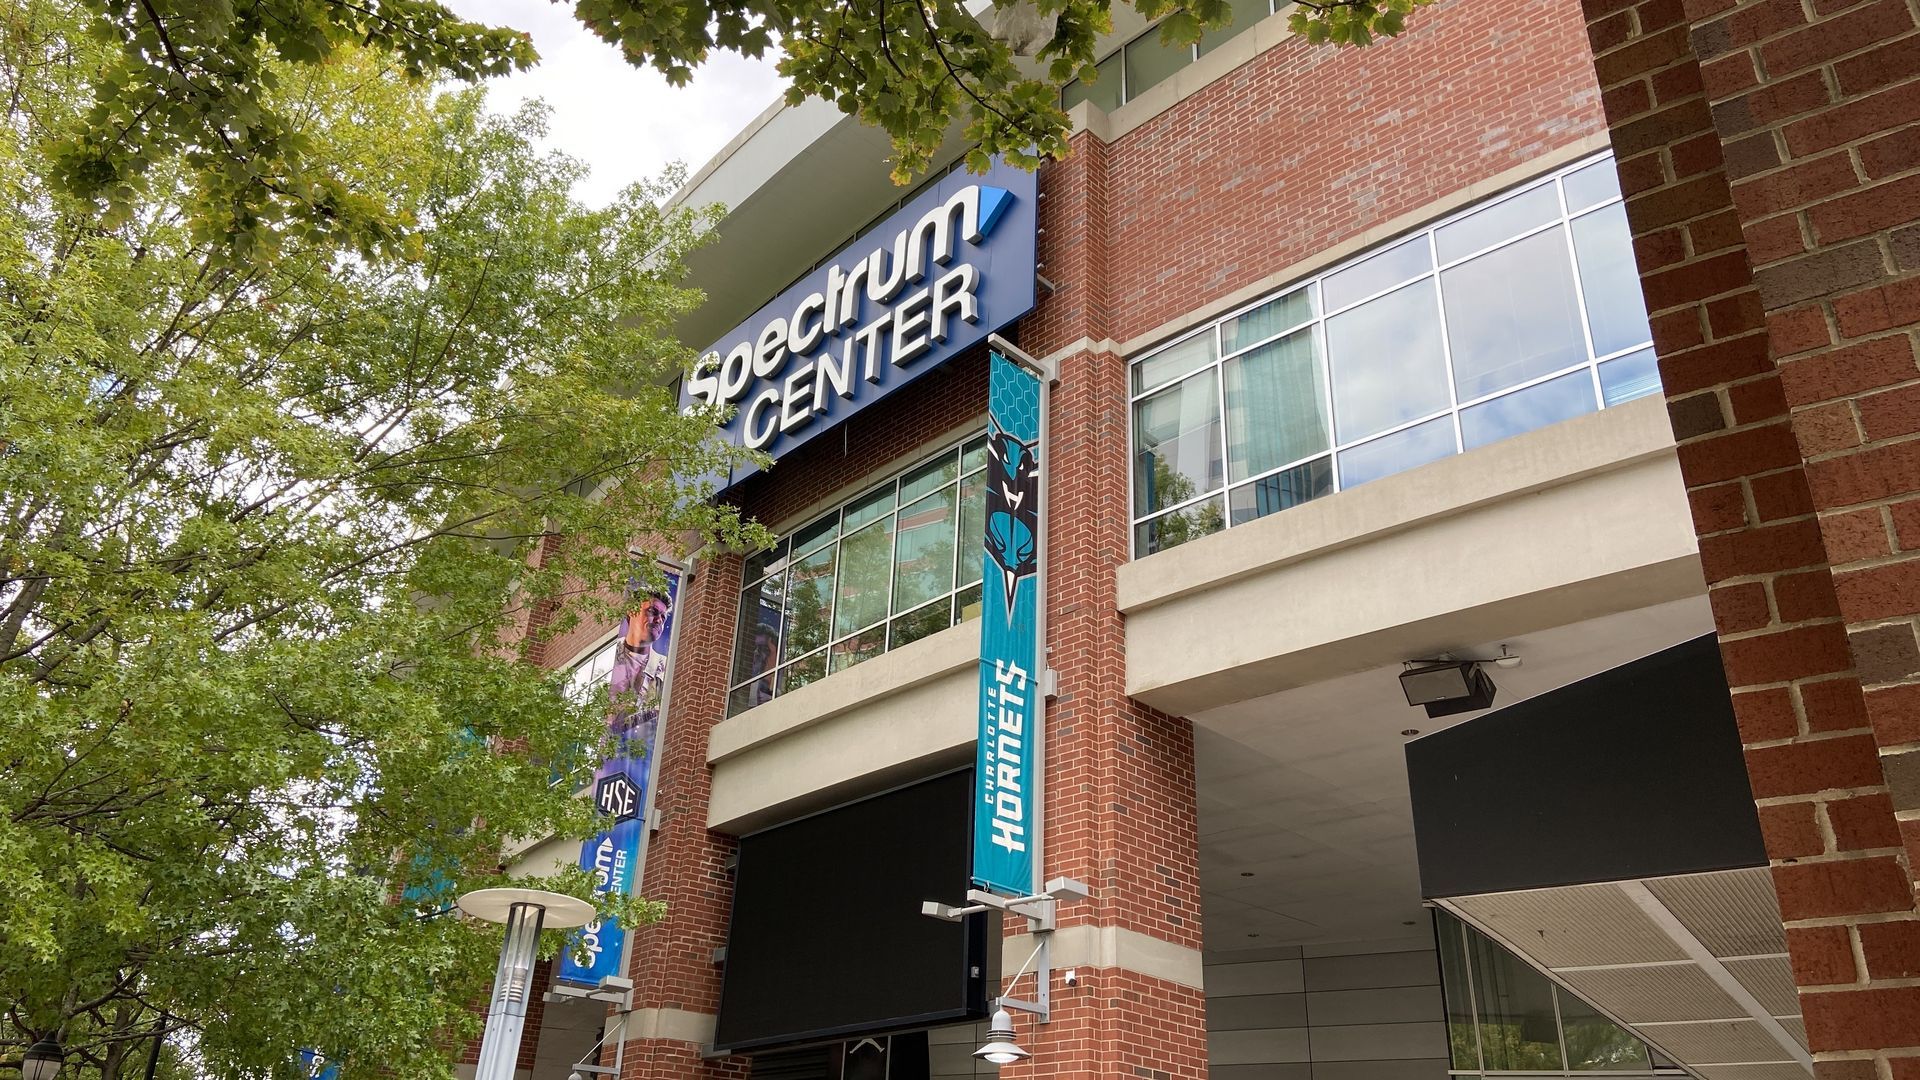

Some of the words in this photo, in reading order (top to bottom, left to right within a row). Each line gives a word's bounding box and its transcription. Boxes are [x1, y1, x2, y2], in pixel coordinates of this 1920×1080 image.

[683, 185, 981, 425] Spectrum
[744, 263, 980, 449] CENTER
[601, 779, 636, 817] HSE
[984, 686, 997, 805] CHARLOTTE
[991, 658, 1027, 855] HORNETS
[610, 849, 628, 898] ENTER
